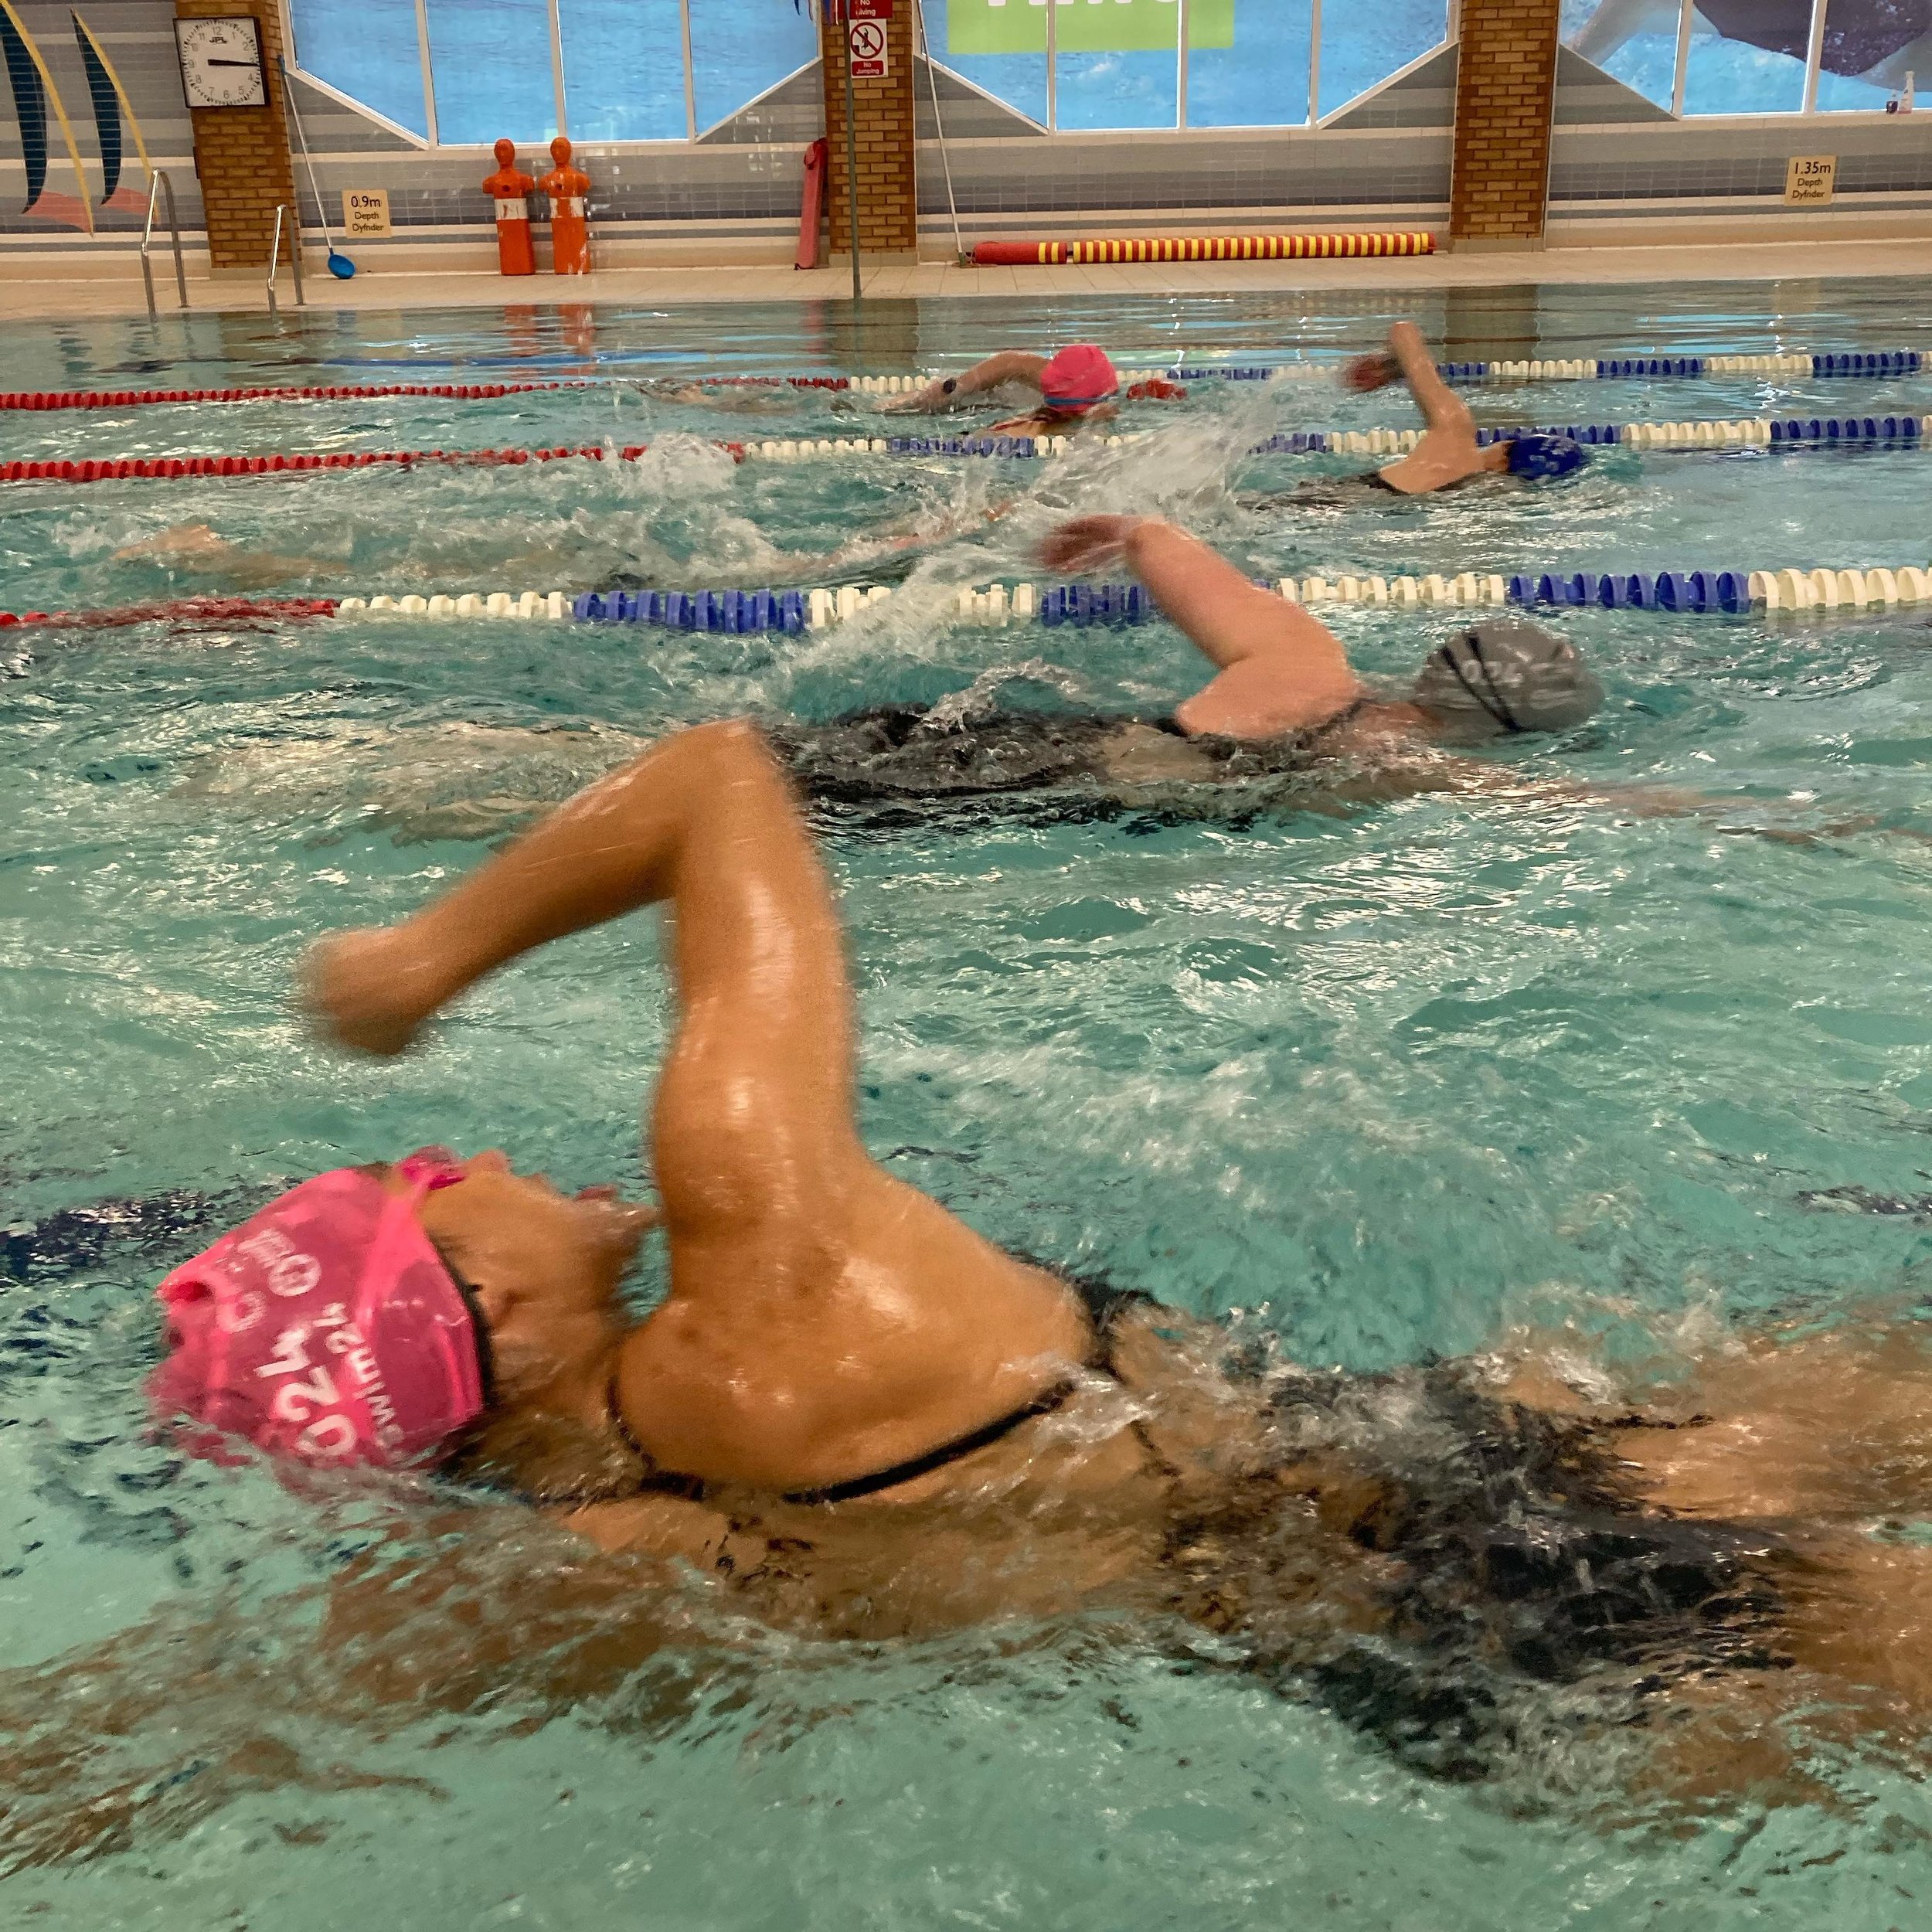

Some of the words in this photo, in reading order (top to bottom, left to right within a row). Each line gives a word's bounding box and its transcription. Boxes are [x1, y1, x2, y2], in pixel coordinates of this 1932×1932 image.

[212, 26, 222, 36] 12
[198, 32, 206, 41] 11
[242, 42, 249, 51] 2
[188, 60, 195, 68] 9
[195, 74, 202, 83] 8
[247, 73, 254, 81] 4
[209, 87, 215, 97] 7
[223, 90, 230, 99] 6
[238, 86, 245, 95] 5
[1794, 161, 1831, 174] 1.35m
[1798, 177, 1823, 188] Depth
[1792, 189, 1825, 201] Dyfnder
[351, 196, 381, 208] 0.9m
[355, 211, 379, 221] Depth
[352, 223, 384, 233] Dyfnder
